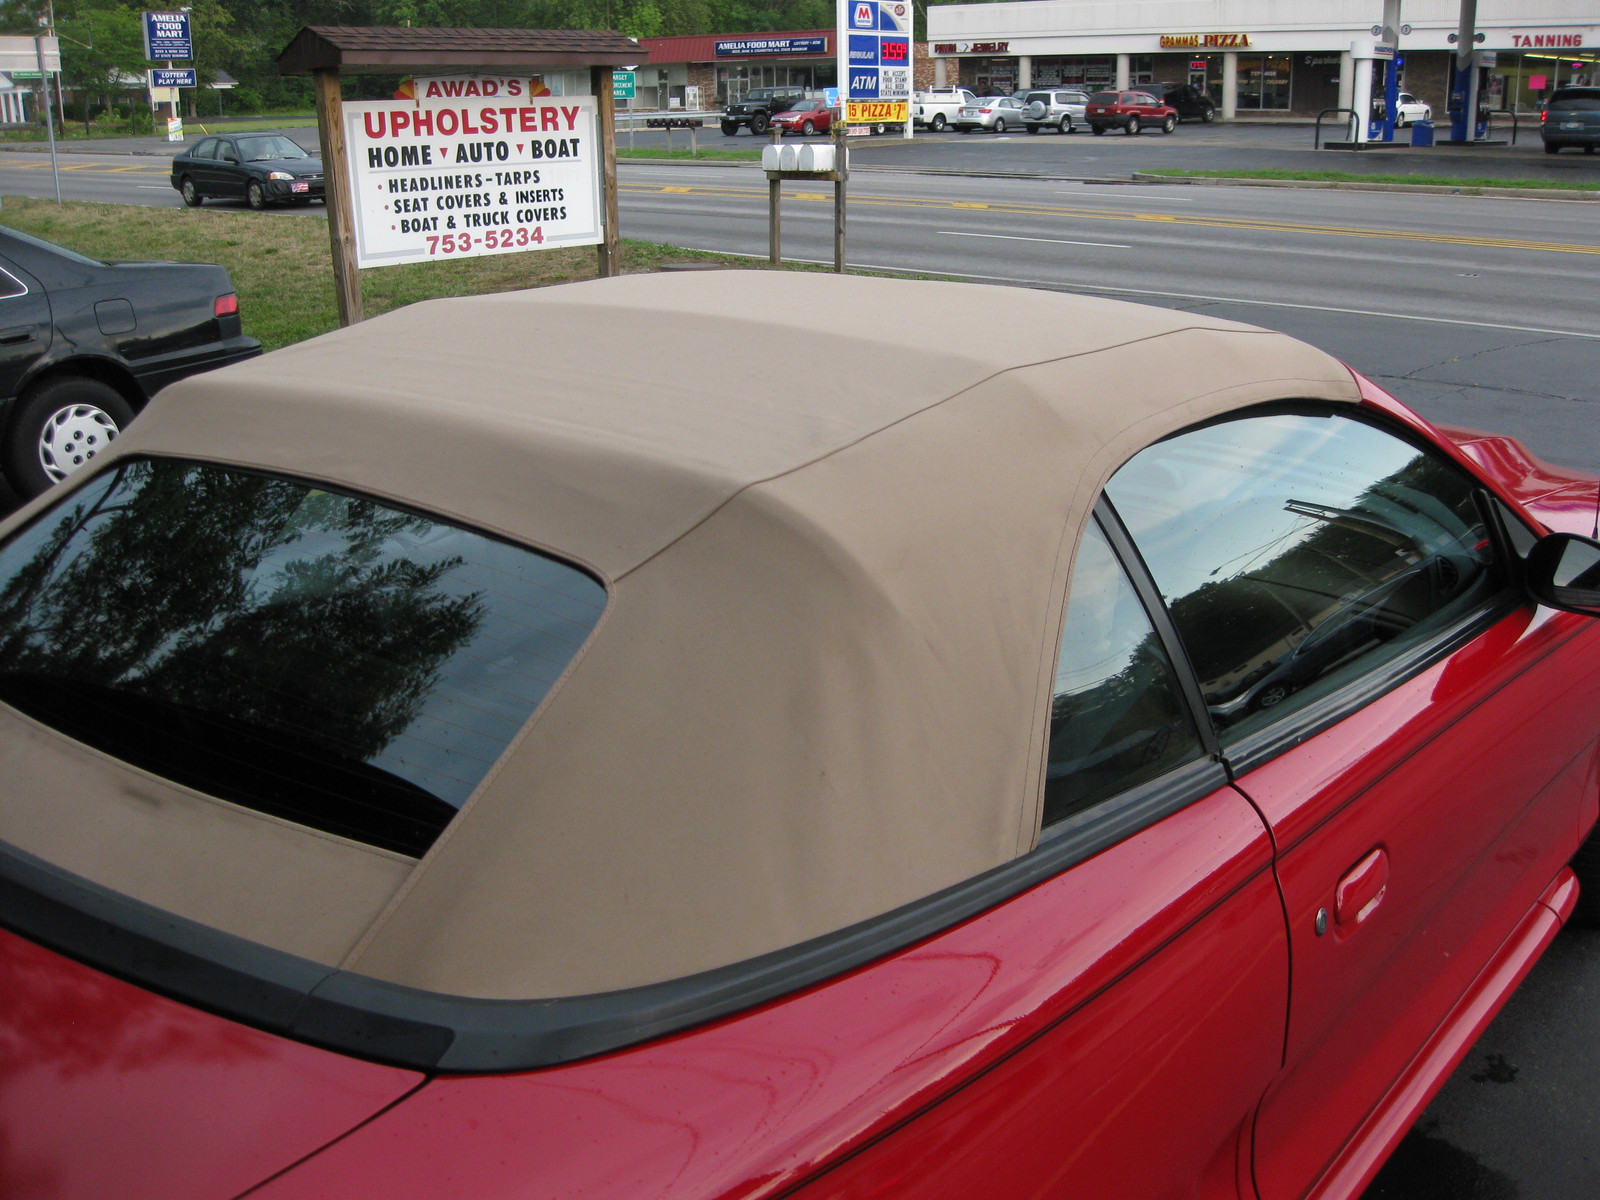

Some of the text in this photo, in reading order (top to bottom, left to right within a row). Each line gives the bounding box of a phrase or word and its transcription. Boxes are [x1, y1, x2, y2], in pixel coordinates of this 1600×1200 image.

[151, 14, 186, 22] AMELIA
[858, 7, 870, 19] M
[157, 22, 182, 30] FOOD
[156, 30, 183, 38] MART
[1203, 33, 1251, 48] PIZZA
[1512, 34, 1583, 48] TANNING
[718, 42, 745, 50] AMELIA
[746, 41, 767, 49] FOOD
[768, 40, 791, 48] MART
[970, 41, 1010, 53] JEWELRY
[426, 79, 523, 98] AWAD'S
[850, 75, 877, 90] ATM
[861, 104, 892, 118] PIZZA
[364, 106, 581, 139] UPHOLSTERY
[367, 138, 581, 169] HOME AUTO BOAT
[388, 170, 541, 194] HEADLINERS-TARPS
[394, 188, 565, 214] SEAT COVERS & INSERTS
[400, 206, 568, 234] BOAT & TRUCK COVERS
[426, 226, 545, 255] 753-5234
